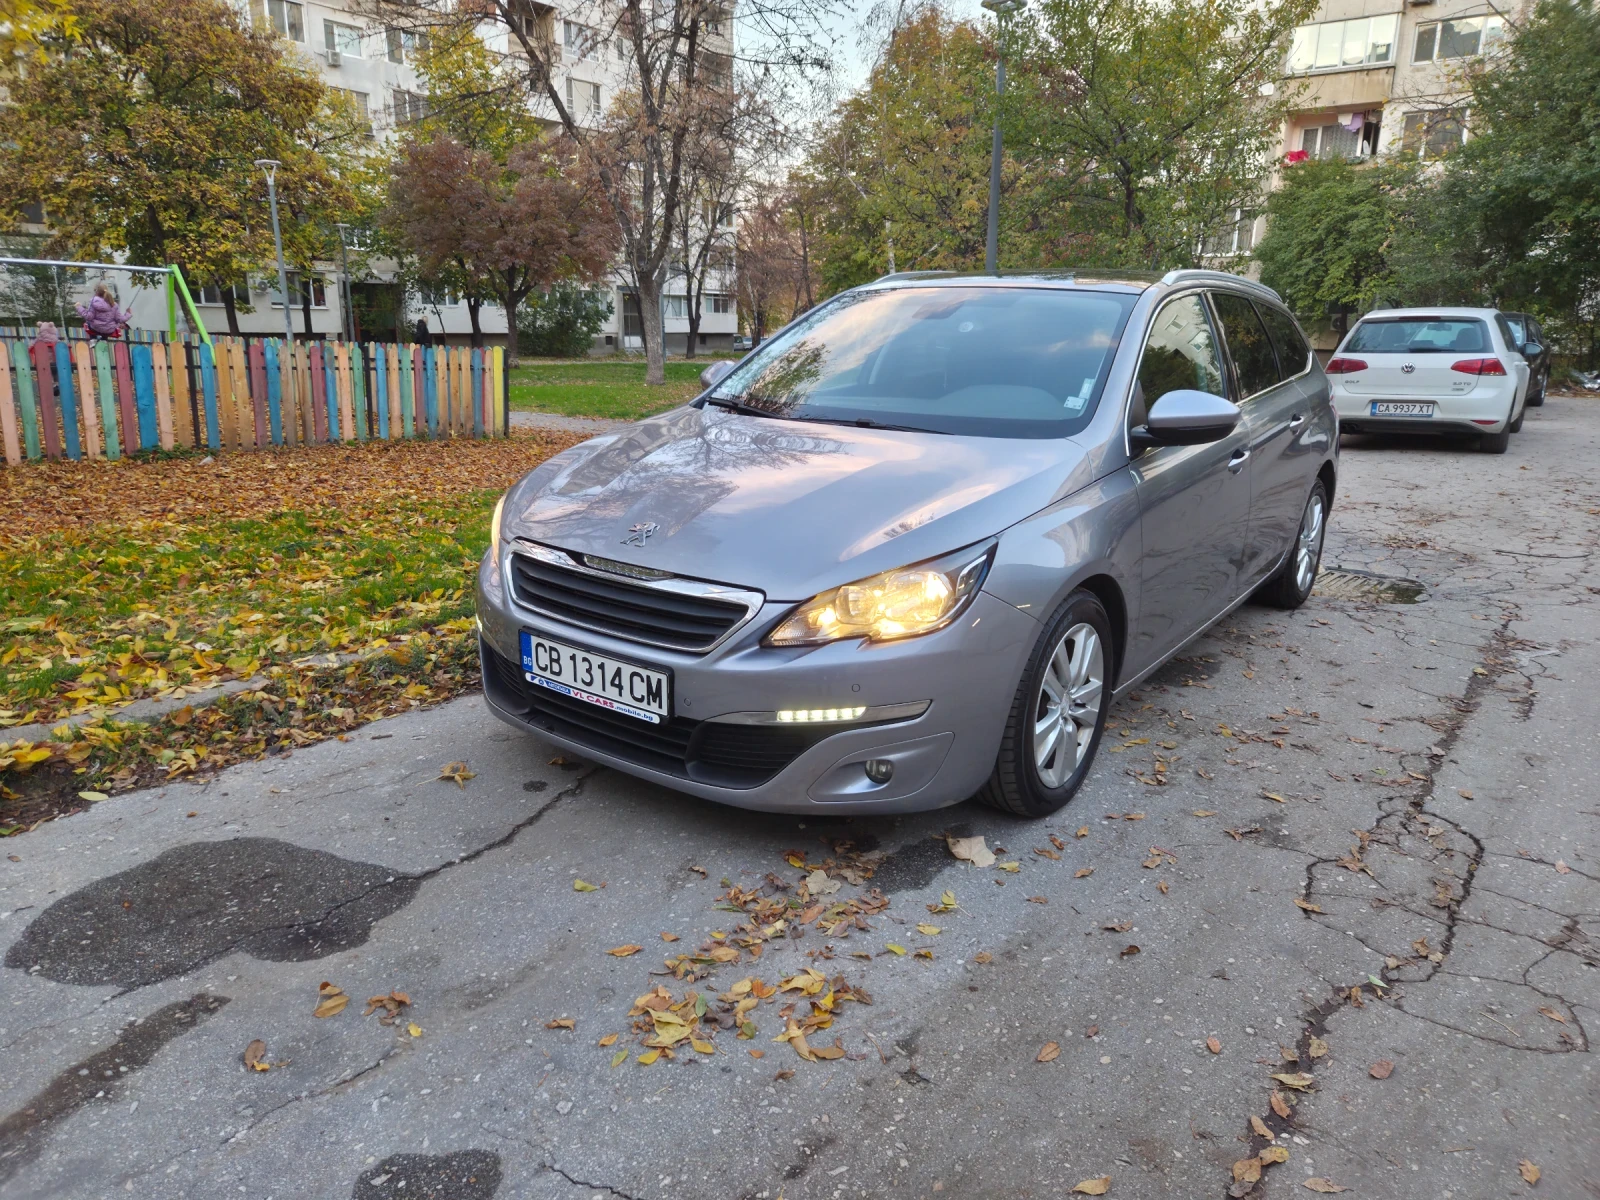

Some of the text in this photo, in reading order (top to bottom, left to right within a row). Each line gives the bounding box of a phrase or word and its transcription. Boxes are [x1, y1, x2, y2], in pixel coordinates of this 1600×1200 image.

[1377, 403, 1432, 414] CA 9937 XT
[523, 655, 532, 666] BG
[535, 642, 663, 710] CB 1314 CM
